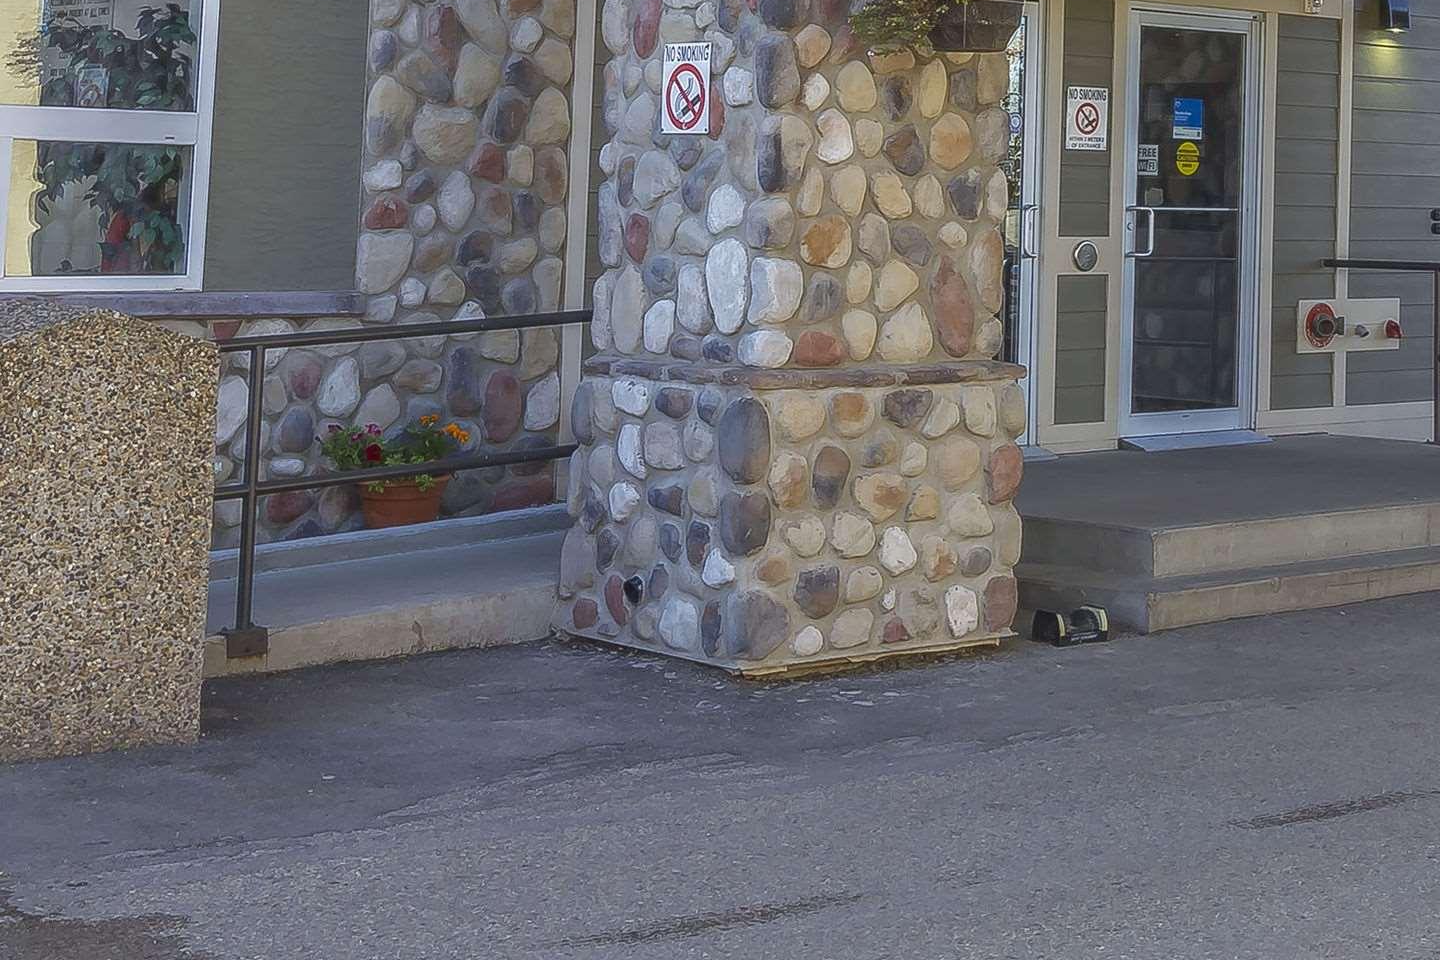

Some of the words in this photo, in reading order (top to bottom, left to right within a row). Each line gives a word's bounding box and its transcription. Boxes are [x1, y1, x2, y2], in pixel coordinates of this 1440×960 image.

[665, 45, 676, 61] NO
[677, 44, 710, 61] SMOKING
[1069, 88, 1078, 100] NO
[1079, 88, 1107, 101] SMOKING
[1138, 148, 1156, 157] FREE
